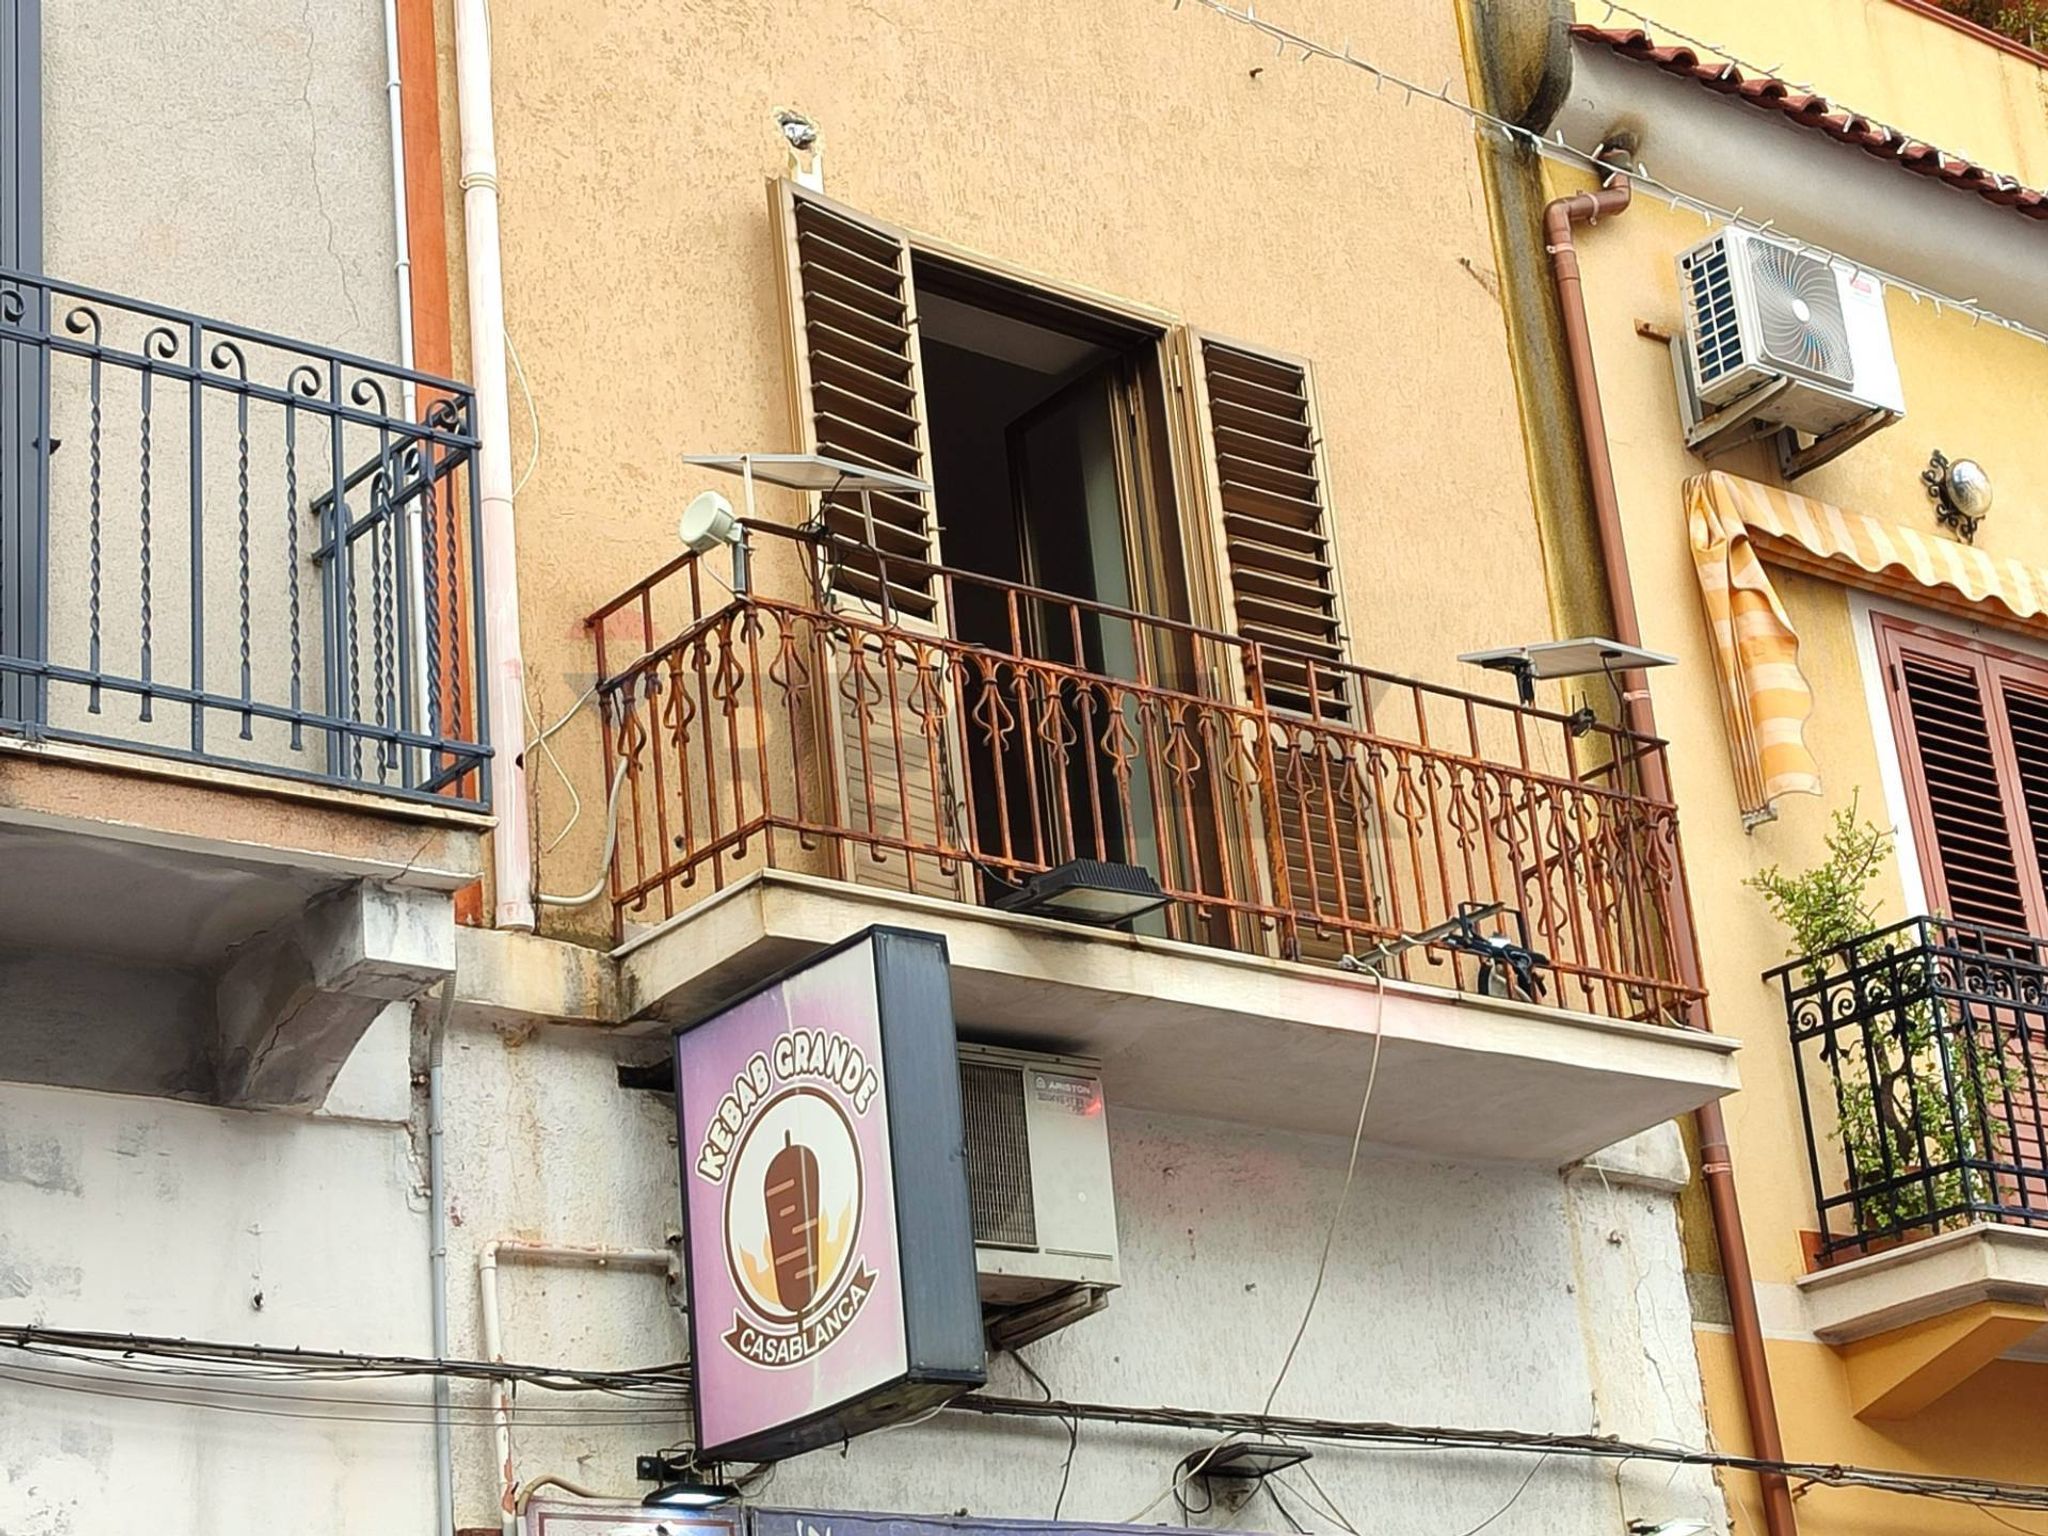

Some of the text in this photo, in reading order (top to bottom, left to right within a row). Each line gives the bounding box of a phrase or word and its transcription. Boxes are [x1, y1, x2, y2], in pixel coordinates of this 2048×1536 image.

[697, 1031, 878, 1182] KEBAB GRANDE
[1048, 1080, 1091, 1095] ARISTON
[740, 1284, 866, 1363] CASABLANCA
